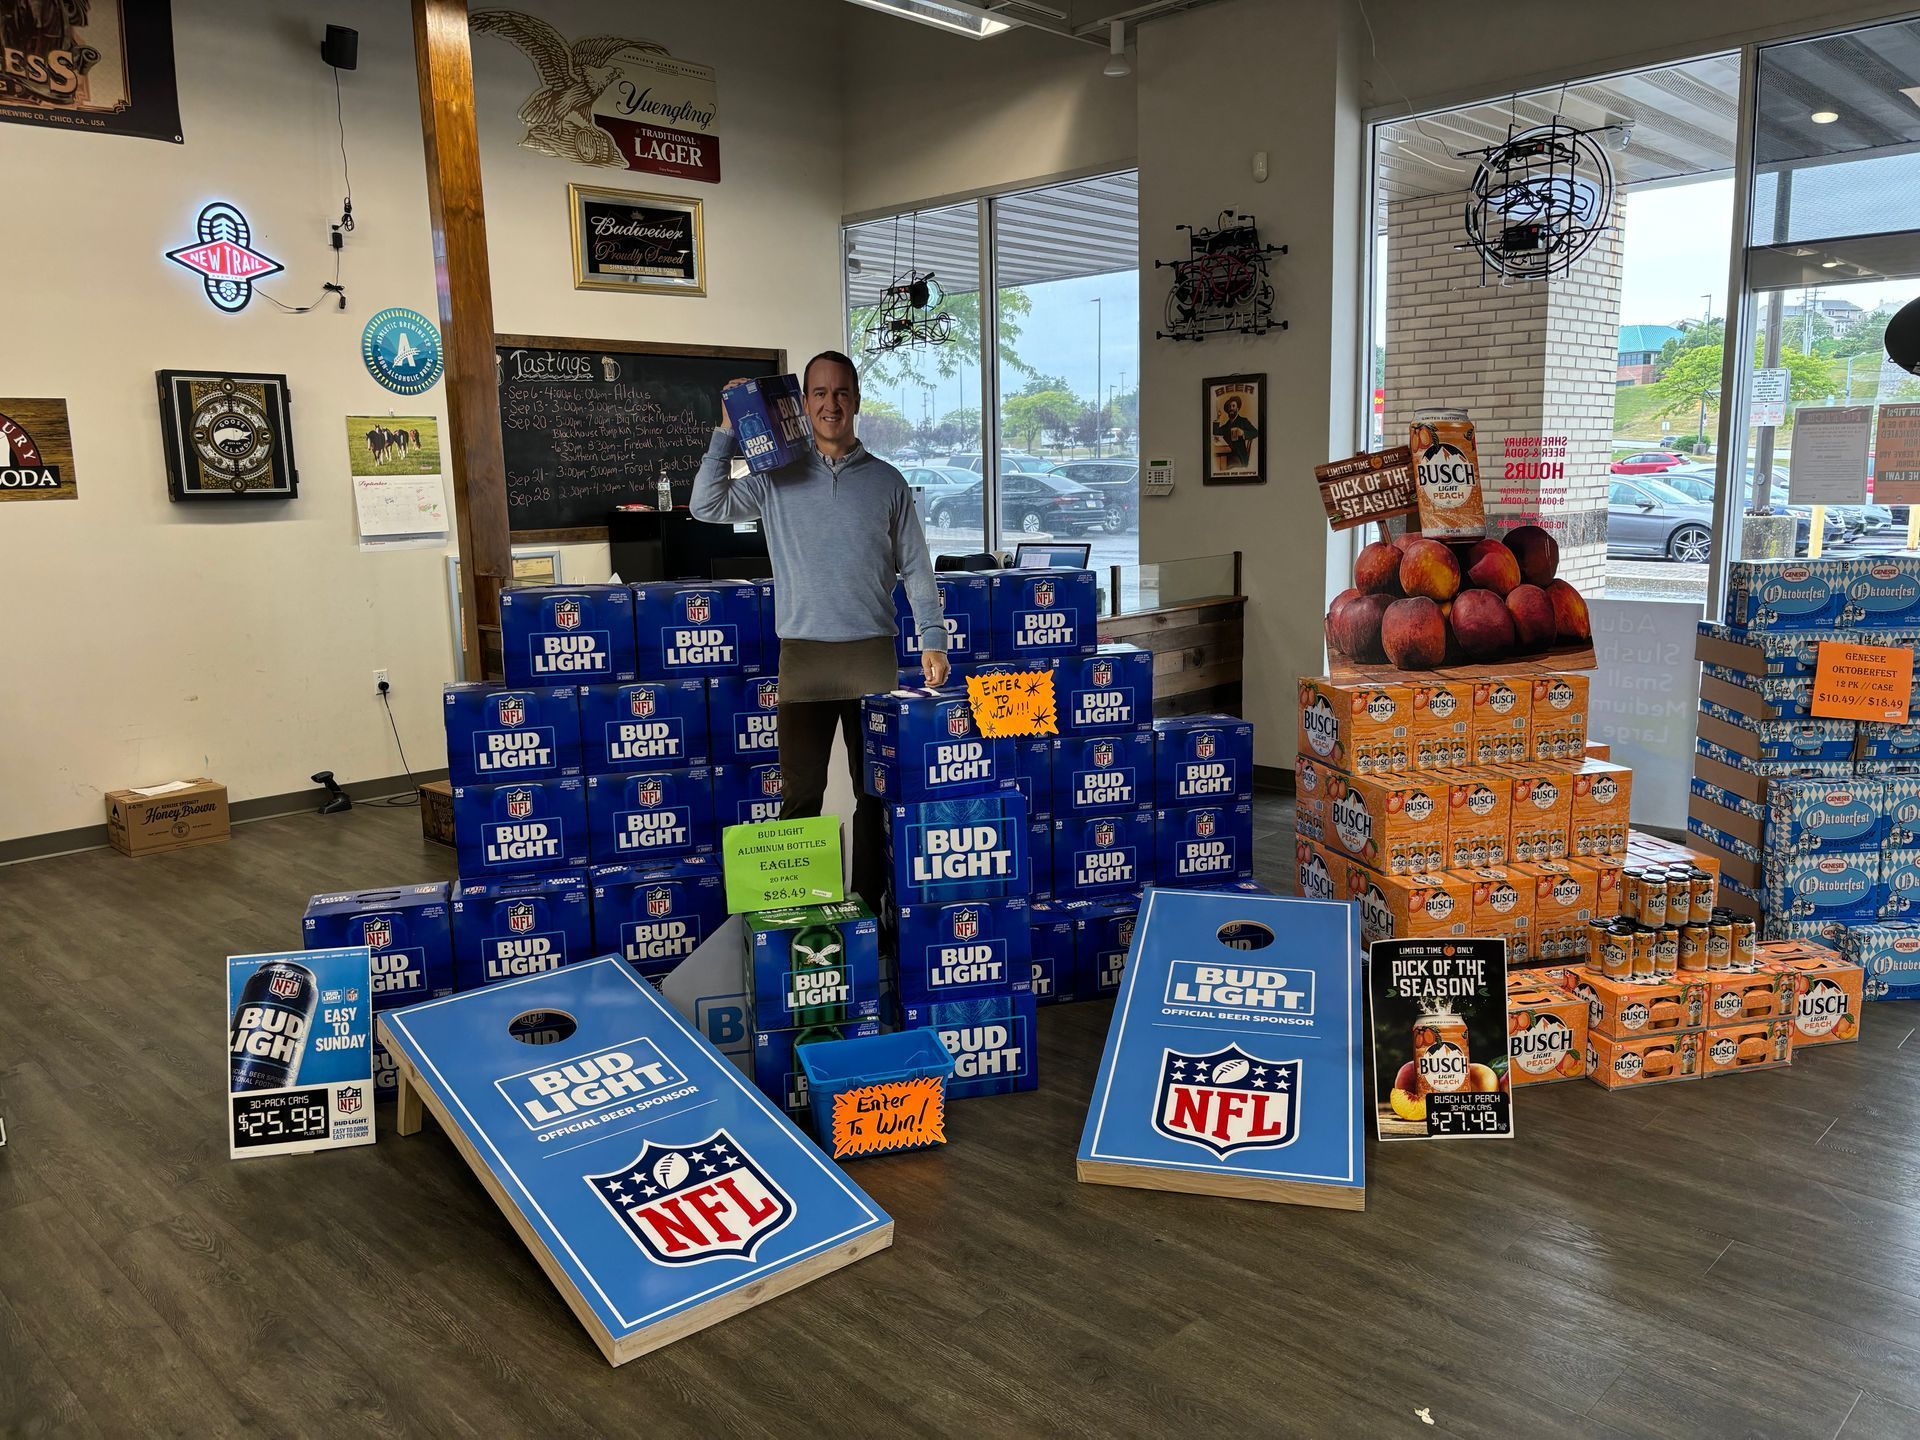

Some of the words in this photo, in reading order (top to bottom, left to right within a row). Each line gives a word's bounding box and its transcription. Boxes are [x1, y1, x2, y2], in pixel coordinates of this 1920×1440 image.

[0, 47, 77, 93] ESS
[616, 81, 717, 130] Yuengling
[91, 119, 105, 127] USA
[641, 128, 697, 145] TRADITIONAL
[634, 137, 703, 167] LAGER
[591, 216, 683, 240] Budweiser
[189, 247, 220, 272] NEW
[224, 246, 262, 275] TRAIL
[595, 241, 643, 265] Proudly
[645, 246, 685, 265] Served
[376, 321, 397, 344] ATHLETIC
[400, 321, 425, 338] BREWING
[377, 355, 419, 382] NON-ALCOHOLIC
[420, 358, 433, 377] BREWS
[510, 350, 592, 377] Tastings
[1214, 384, 1255, 397] BEER
[777, 396, 800, 419] BUD
[219, 419, 245, 429] GOOSE
[780, 415, 811, 442] LIGHT
[220, 442, 250, 453] ISLAND
[744, 441, 775, 458] LIGHT
[745, 434, 768, 449] BUD
[1327, 464, 1353, 477] LIMITED
[1353, 460, 1370, 471] TIME
[1383, 452, 1401, 465] ONLY
[0, 469, 58, 488] ODA
[1417, 464, 1476, 486] BUSCH
[1329, 476, 1361, 510] PICK
[1364, 474, 1381, 489] OF
[1385, 467, 1415, 495] THE
[1433, 491, 1464, 500] PEACH
[1764, 584, 1826, 601] Oktoberfest
[1851, 582, 1916, 600] Oktoberfest
[1025, 612, 1066, 630] BUD
[544, 635, 595, 654] BUD
[1016, 627, 1073, 645] LIGHT
[535, 652, 606, 672] LIGHT
[1845, 652, 1887, 664] GENESEE
[1832, 664, 1898, 678] OKTOBERFEST
[981, 678, 1022, 697] ENTER
[1835, 680, 1846, 689] 12
[1847, 681, 1859, 689] PK
[1871, 682, 1894, 692] CASE
[994, 694, 1010, 706] TO
[1368, 701, 1396, 714] BUSCH
[1867, 697, 1904, 709] $18.49
[989, 701, 1031, 720] WIN!!!
[620, 723, 670, 741] BUD
[1303, 709, 1339, 740] BUSCH
[611, 739, 680, 759] LIGHT
[937, 742, 984, 764] BUD
[929, 758, 991, 784] LIGHT
[141, 806, 180, 826] Honey
[180, 803, 217, 818] Brown
[1404, 799, 1434, 813] BUSCH
[1332, 804, 1373, 836] BUSCH
[1806, 810, 1869, 828] Oktoberfest
[496, 823, 547, 843] BUD
[758, 829, 776, 839] BUD
[778, 827, 804, 837] LIGHT
[926, 825, 998, 854] BUD
[487, 839, 559, 861] LIGHT
[738, 843, 785, 856] ALUMINUM
[786, 839, 826, 851] BOTTLES
[1186, 841, 1226, 858] BUD
[760, 857, 810, 871] EAGLES
[914, 850, 1009, 882] LIGHT
[1179, 855, 1231, 874] LIGHT
[781, 874, 799, 882] PACK
[764, 887, 806, 901] $28.49
[940, 945, 992, 966] BUD
[1426, 946, 1442, 954] TIME
[1456, 946, 1474, 954] ONLY
[796, 970, 841, 991] BUD
[931, 963, 1002, 987] LIGHT
[1195, 966, 1287, 989] BUD
[1392, 960, 1432, 987] PICK
[1433, 959, 1451, 976] OF
[1455, 960, 1487, 986] THE
[273, 976, 300, 998] NFL
[787, 985, 849, 1008] LIGHT
[1173, 982, 1304, 1010] LIGHT
[1399, 978, 1475, 997] SEASON
[239, 1007, 305, 1041] BUD
[324, 1007, 357, 1023] EASY
[1161, 1007, 1215, 1020] OFFICIAL
[1218, 1012, 1250, 1022] BEER
[1253, 1014, 1314, 1027] SPONSOR
[1804, 1019, 1833, 1031] PEACH
[332, 1022, 350, 1036] TO
[315, 1034, 366, 1052] SUNDAY
[1510, 1028, 1573, 1057] BUSCH
[527, 1048, 635, 1095] BUD
[1419, 1057, 1468, 1074] BUSCH
[250, 1097, 287, 1109] 30-PACK
[288, 1095, 309, 1106] CANS
[523, 1060, 675, 1124] LIGHT
[1434, 1095, 1460, 1104] BUSCH
[1461, 1095, 1472, 1104] LT
[1474, 1094, 1500, 1103] PEACH
[340, 1097, 361, 1111] NFL
[857, 1092, 911, 1114] Enter
[238, 1105, 325, 1137] $25.99
[537, 1117, 599, 1143] OFFICIAL
[599, 1104, 636, 1126] BEER
[635, 1084, 700, 1114] SPONSOR
[846, 1120, 862, 1136] To
[877, 1098, 929, 1134] Win!
[1169, 1087, 1281, 1142] NFL
[1431, 1111, 1497, 1132] $27.49
[637, 1173, 779, 1254] NFL
